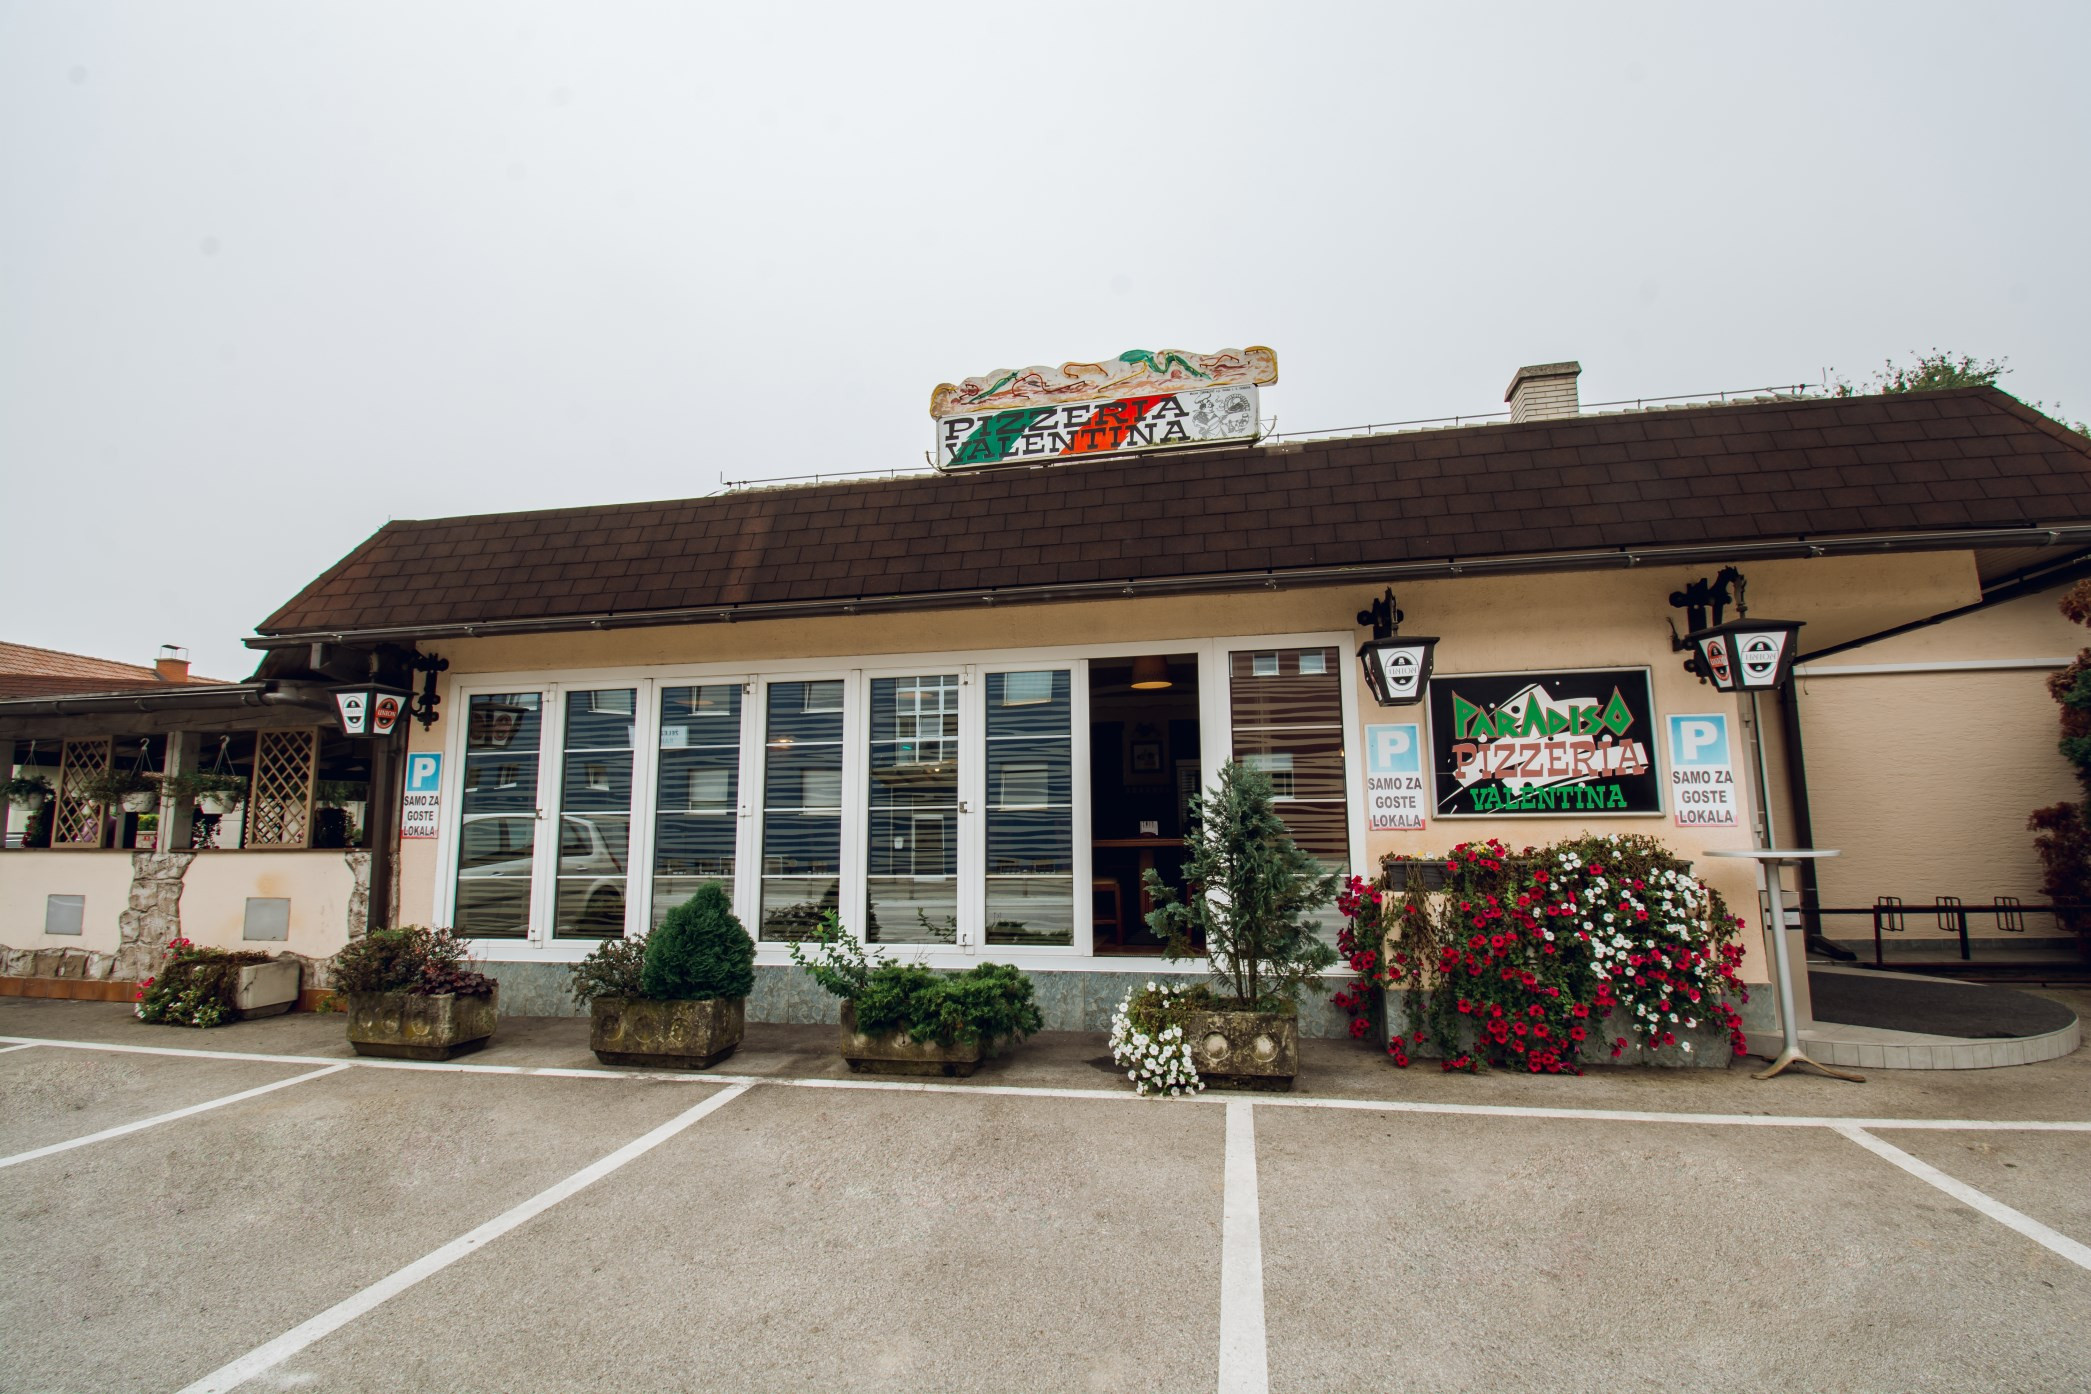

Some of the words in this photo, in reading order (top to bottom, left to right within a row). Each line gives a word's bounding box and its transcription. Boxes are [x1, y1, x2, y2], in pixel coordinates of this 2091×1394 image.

[944, 396, 1189, 441] PIZZERIA
[946, 420, 1191, 463] VALENTINA
[1452, 685, 1634, 740] PARADISO
[1680, 720, 1718, 760] P
[1377, 731, 1410, 768] P
[1452, 738, 1648, 780] PIZZERIA
[412, 757, 437, 788] P
[1672, 770, 1711, 784] SAMO
[1714, 770, 1733, 783] ZA
[1368, 777, 1402, 790] SAMO
[1405, 777, 1422, 790] ZA
[403, 795, 427, 806] SAMO
[428, 795, 439, 806] ZA
[1375, 796, 1416, 809] GOSTE
[1470, 784, 1628, 811] VALENTINA
[1682, 790, 1727, 803] GOSTE
[407, 810, 434, 821] GOSTE
[1372, 814, 1421, 827] LOKALA
[1679, 809, 1733, 823] LOKALA
[403, 825, 435, 836] LOKALA
